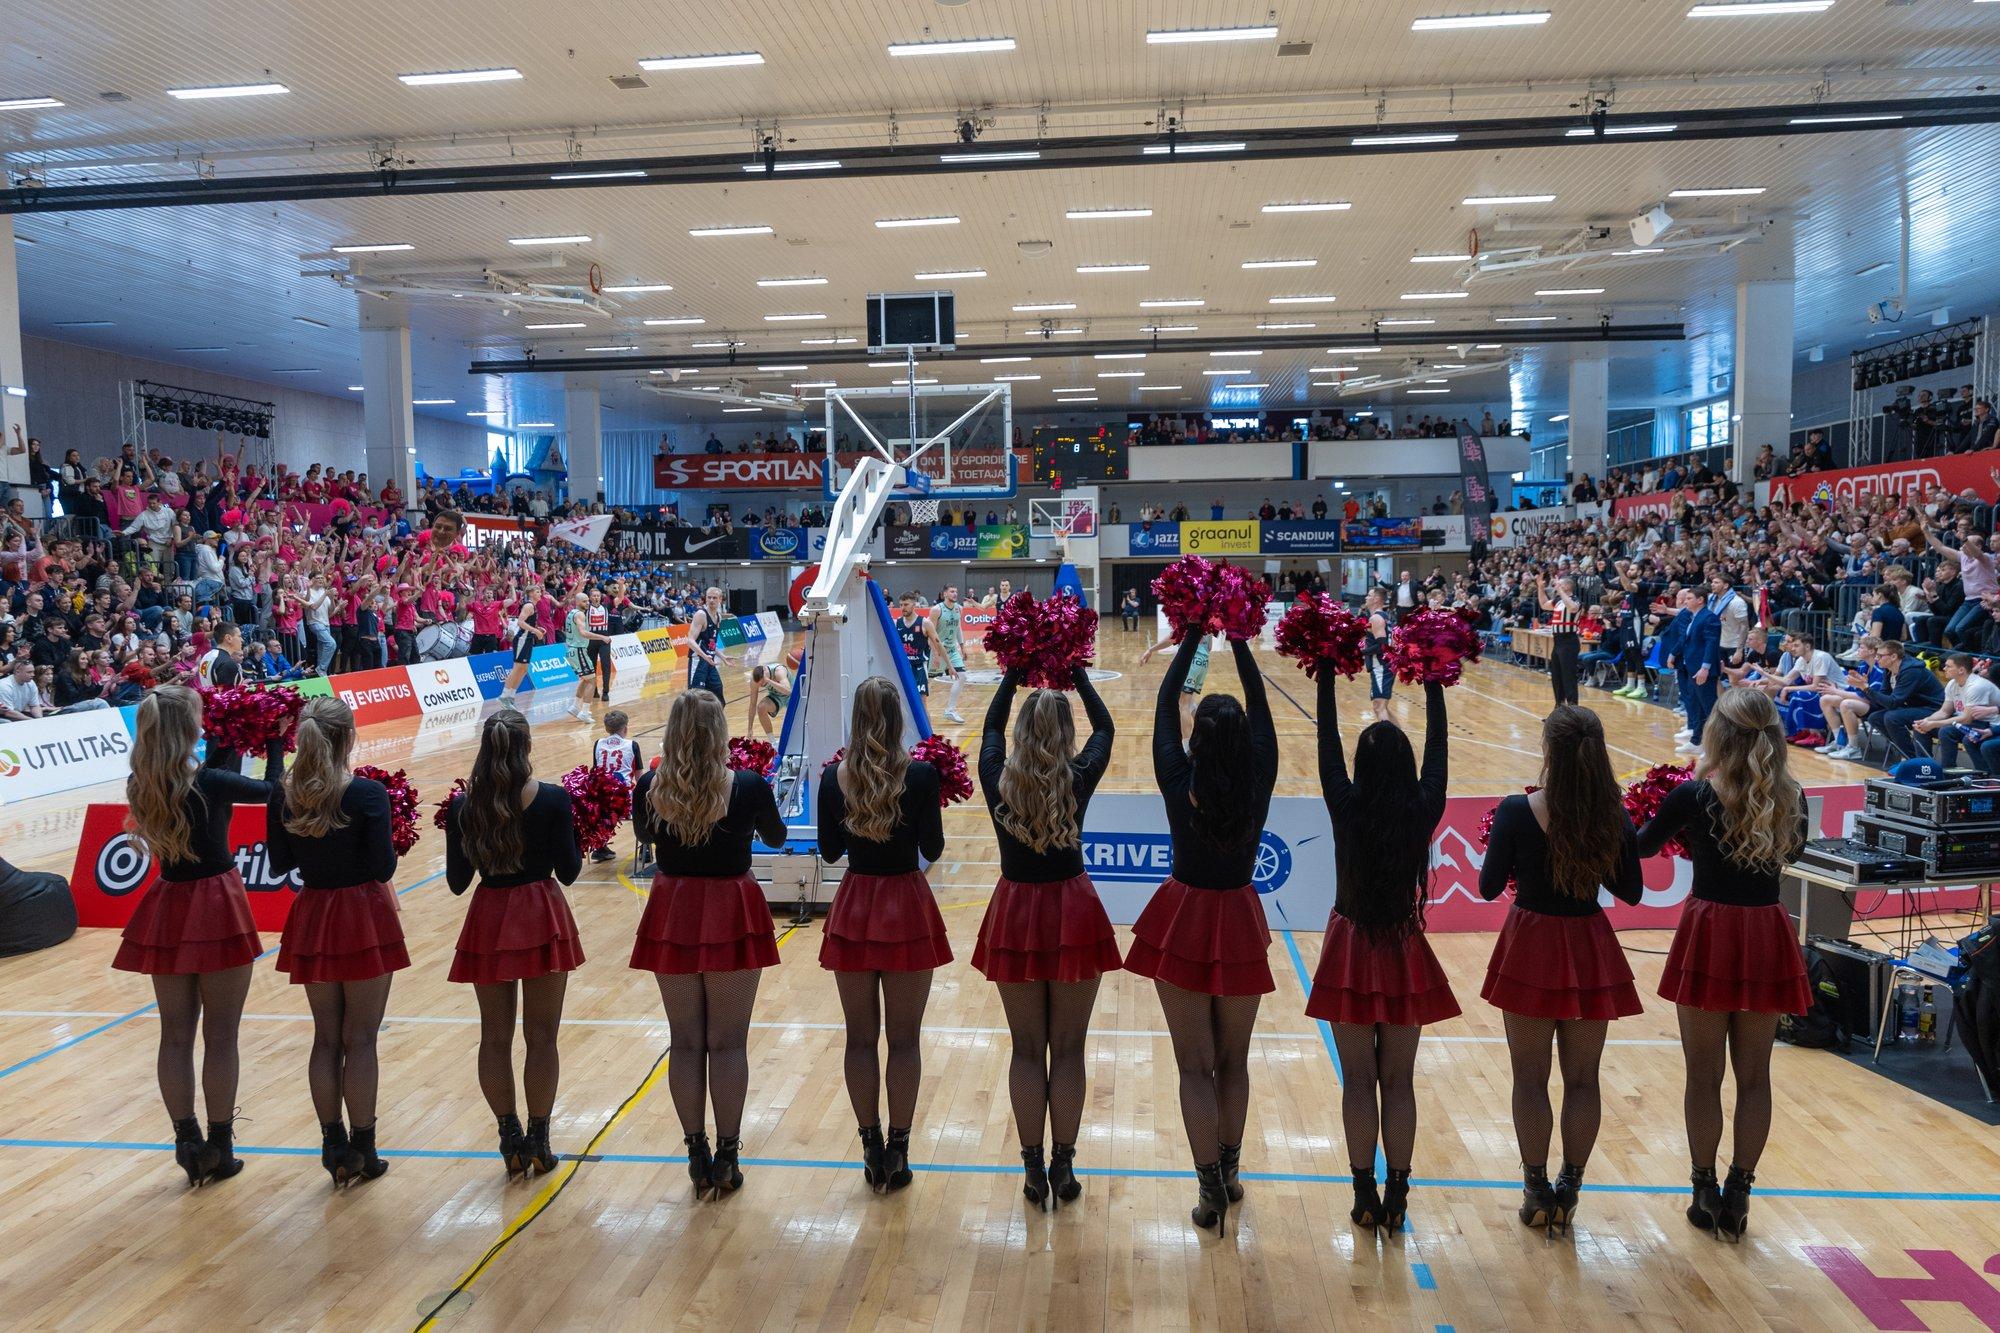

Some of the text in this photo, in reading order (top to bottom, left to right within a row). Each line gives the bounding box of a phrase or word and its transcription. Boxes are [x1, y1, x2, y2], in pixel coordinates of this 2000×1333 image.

[703, 460, 842, 482] SPORTLAN
[637, 531, 652, 556] DO
[1190, 525, 1251, 549] graanul
[1221, 540, 1251, 549] invest
[1277, 531, 1335, 541] SCANDIUM
[902, 633, 914, 642] 14
[357, 683, 411, 706] EVENTUS
[423, 686, 475, 707] CONNECTO
[23, 731, 128, 770] UTILITAS
[601, 749, 623, 772] 13
[1081, 842, 1172, 868] KRIVE
